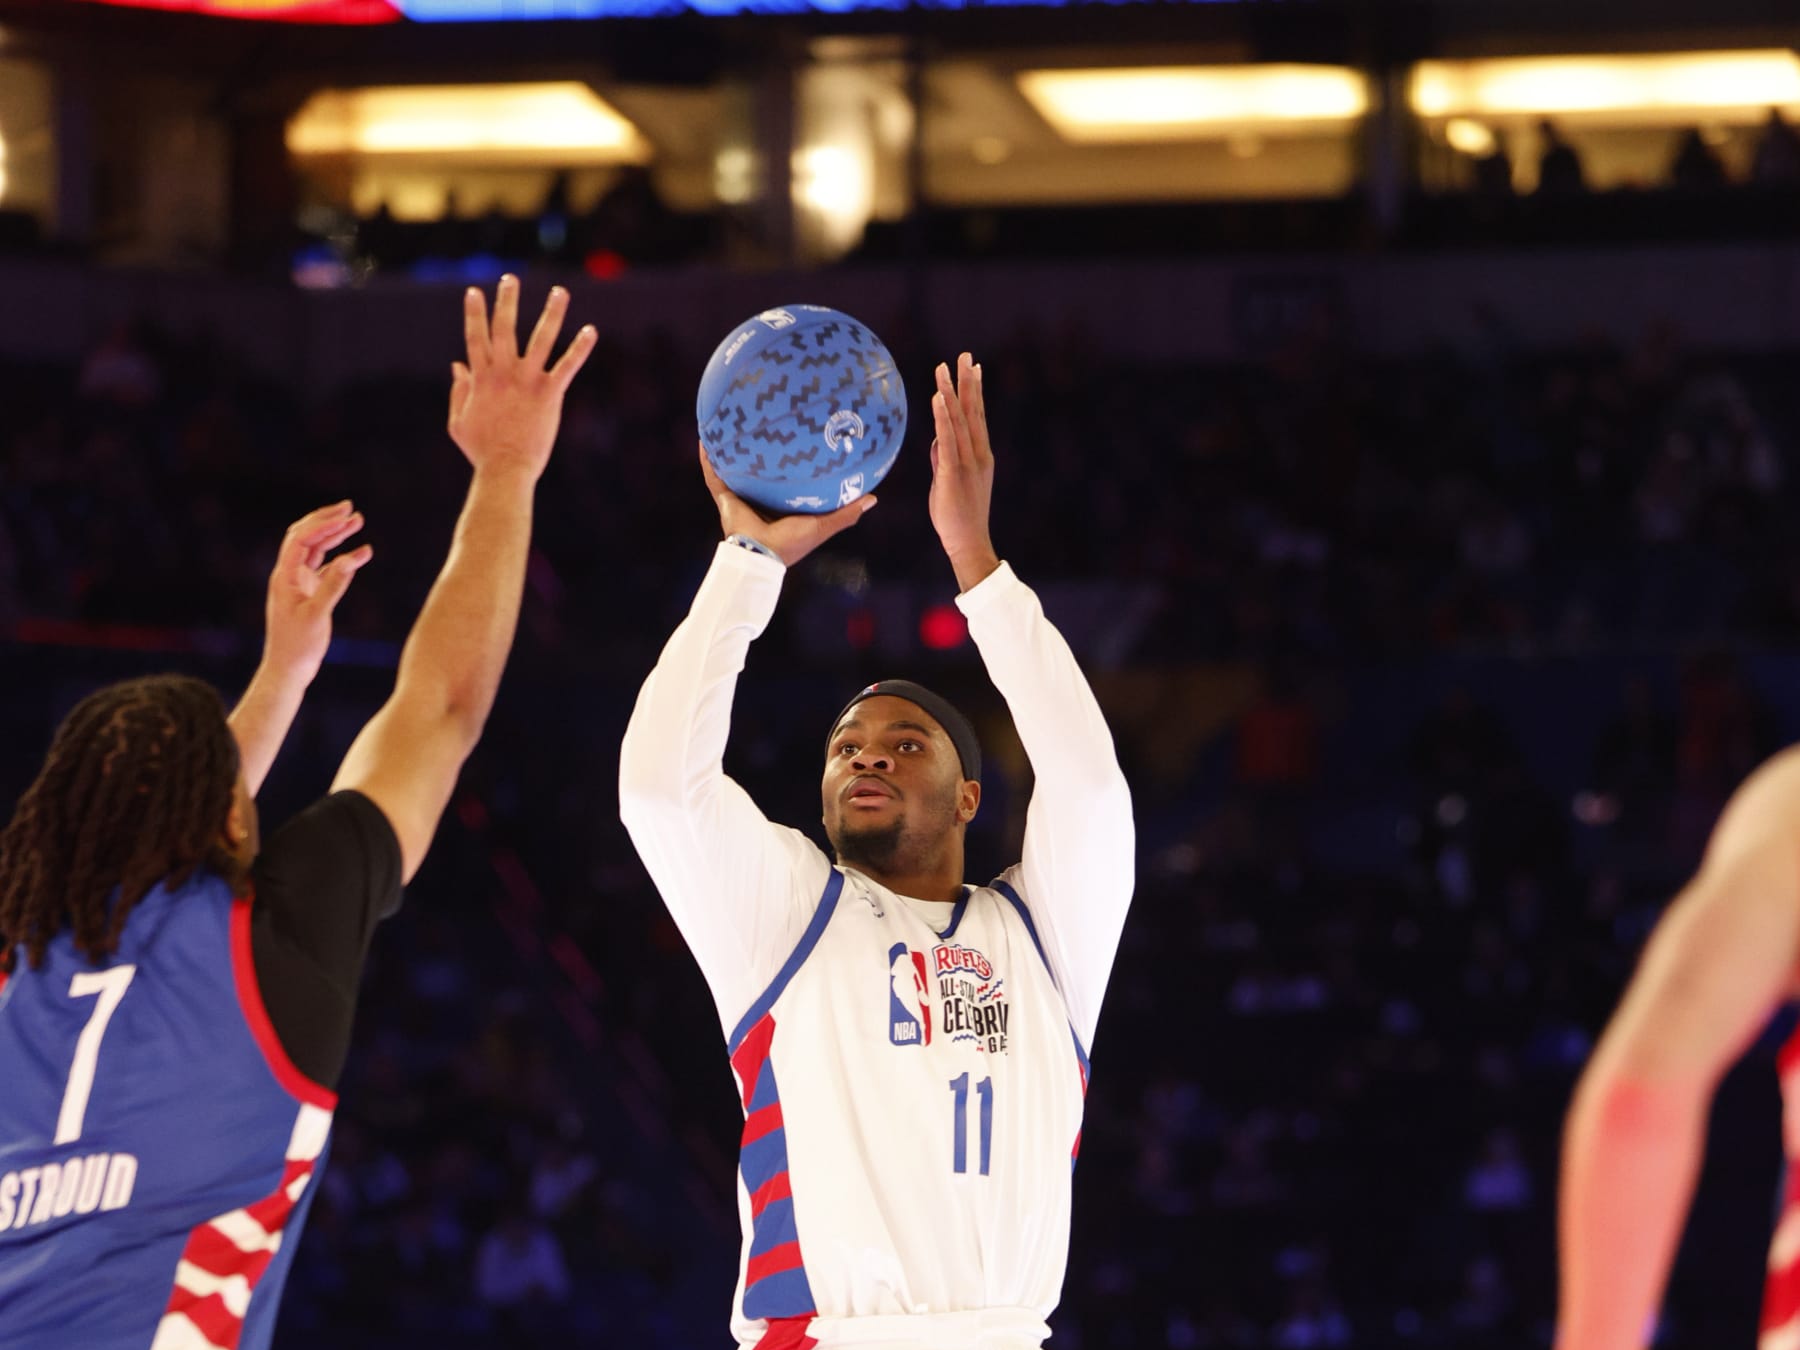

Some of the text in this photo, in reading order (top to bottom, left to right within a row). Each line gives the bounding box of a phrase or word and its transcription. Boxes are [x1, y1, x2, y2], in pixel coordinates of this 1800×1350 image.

[935, 946, 990, 977] RUFLES
[54, 964, 137, 1146] 7
[894, 1021, 917, 1041] NBA
[949, 1072, 994, 1177] 11
[0, 1152, 139, 1233] STROUD
